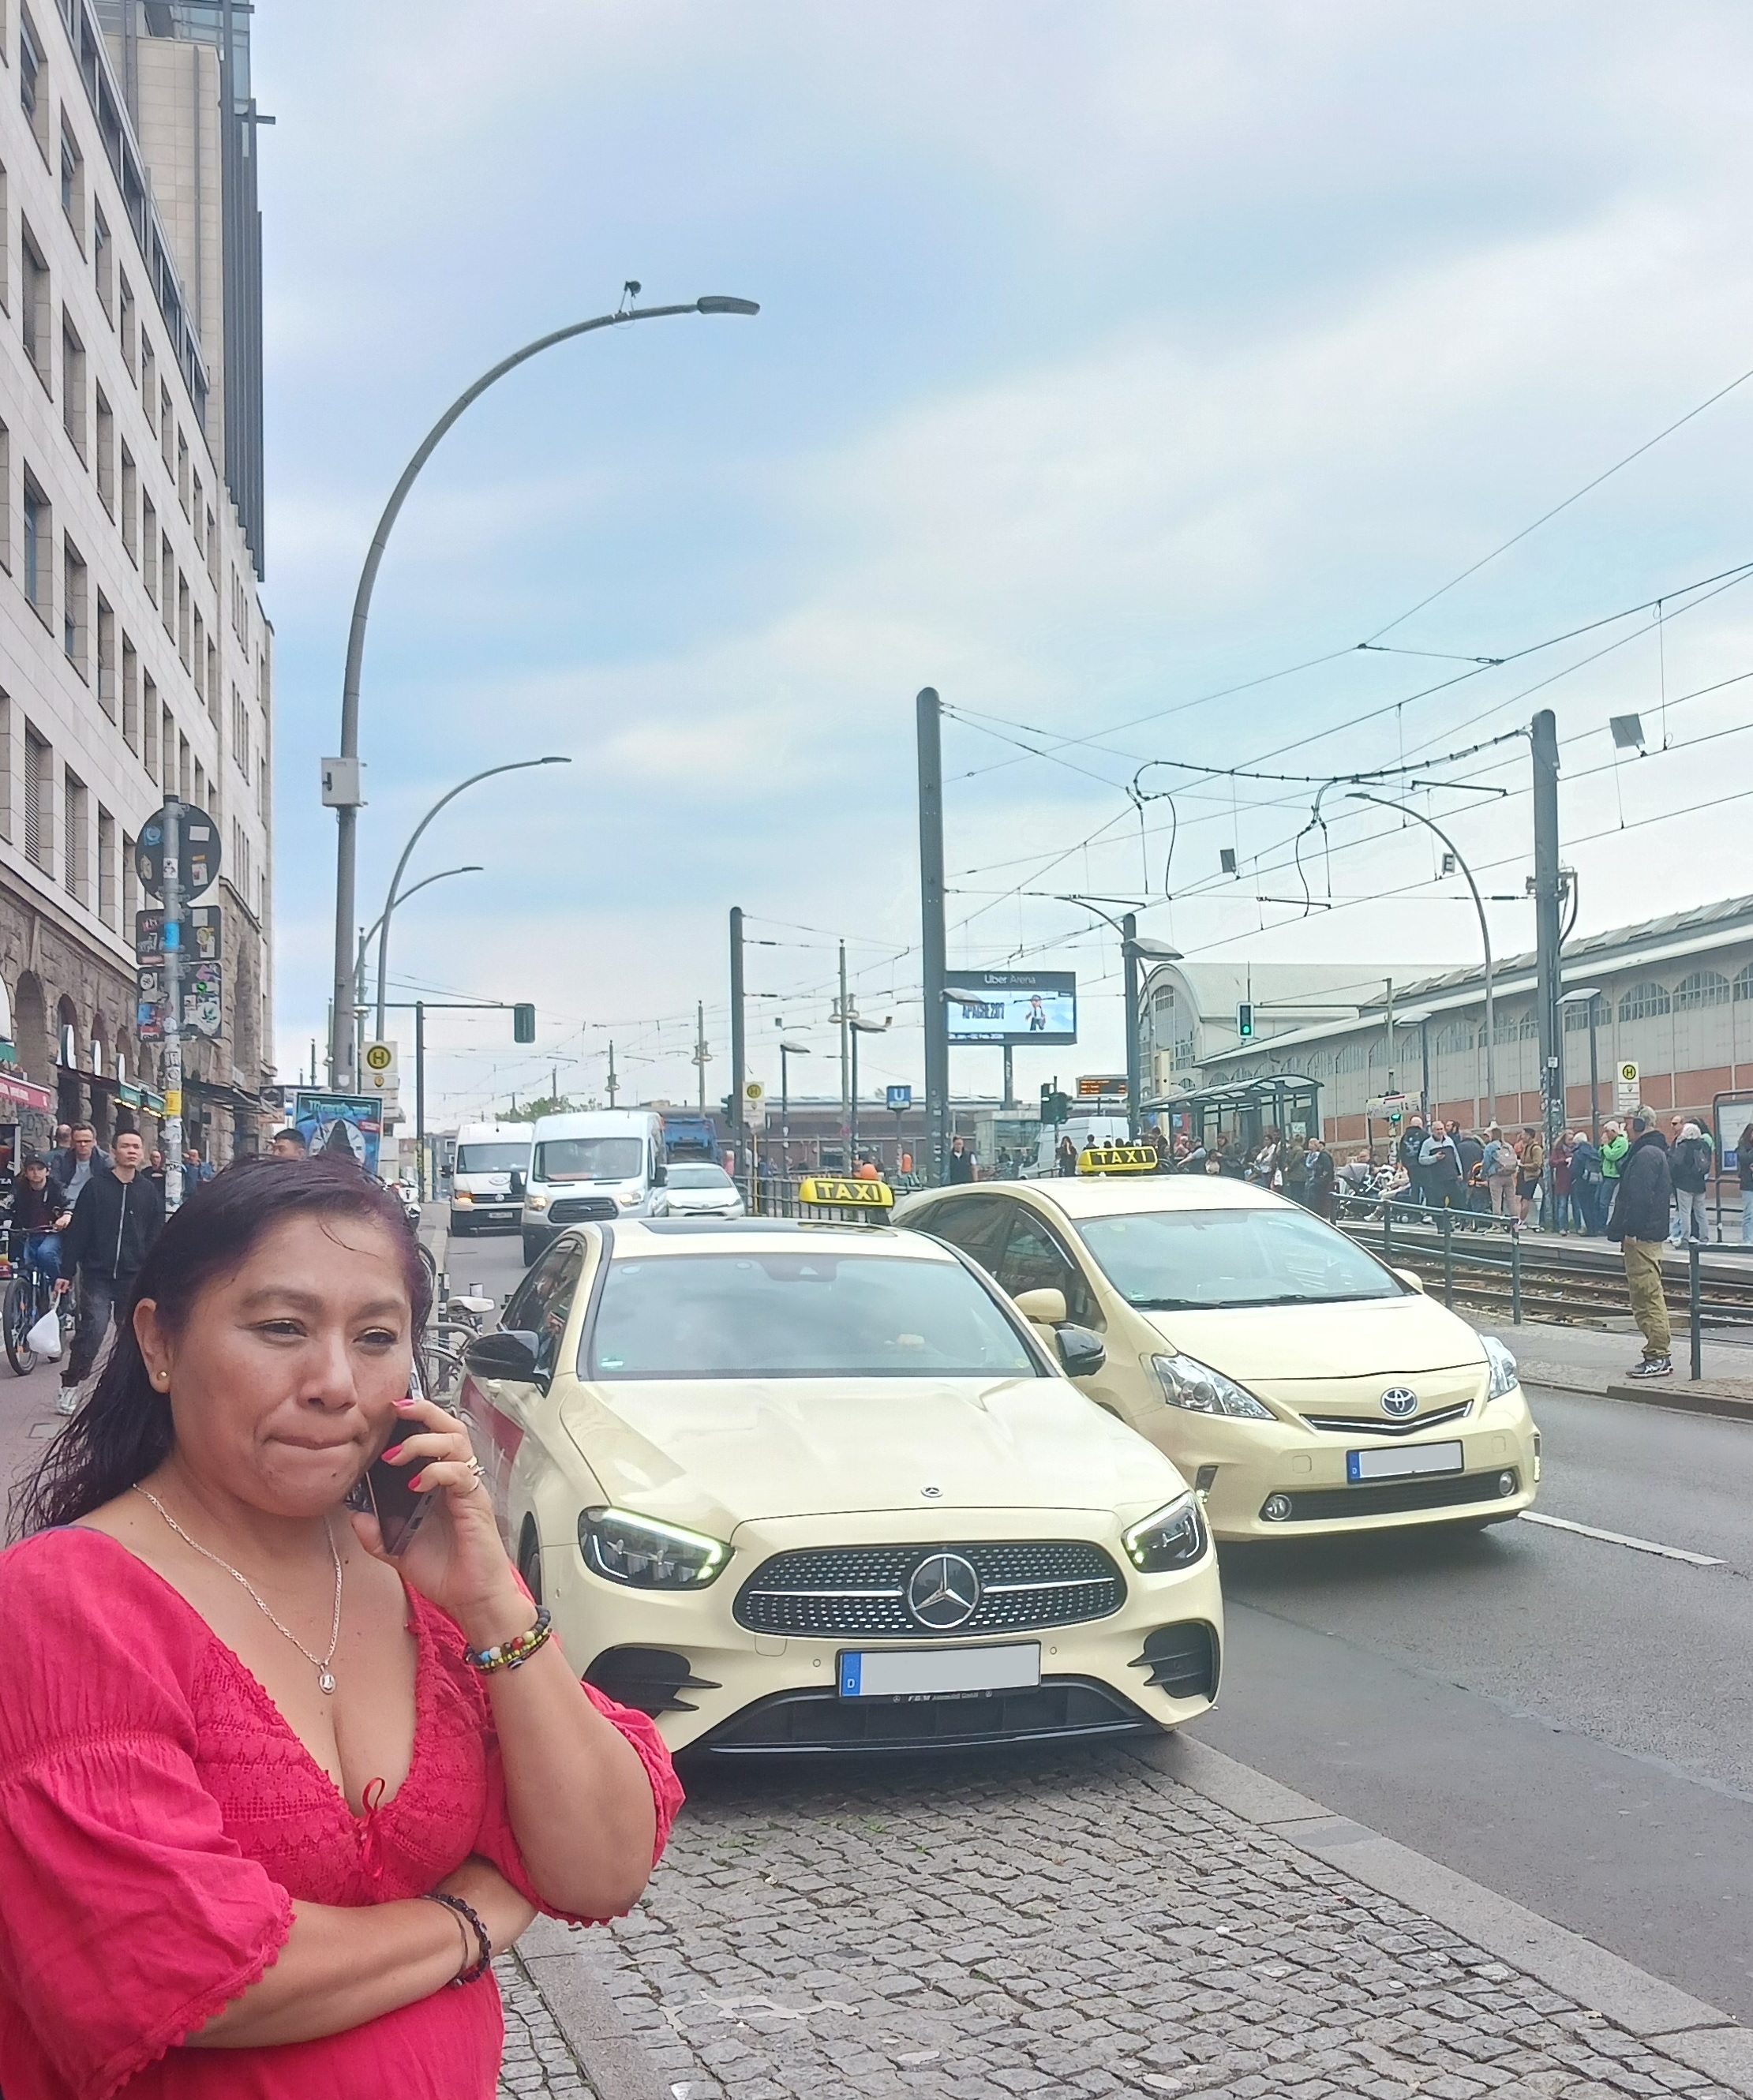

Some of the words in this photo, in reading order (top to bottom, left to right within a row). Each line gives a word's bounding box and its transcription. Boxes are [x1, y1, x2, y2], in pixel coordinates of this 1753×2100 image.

[1444, 855, 1454, 871] E
[984, 974, 1007, 984] Uber
[1009, 974, 1036, 984] Arena
[373, 1051, 384, 1064] H
[893, 1088, 905, 1101] U
[1097, 1150, 1147, 1164] TAXI
[818, 1182, 880, 1201] TAXI
[847, 1678, 856, 1689] D
